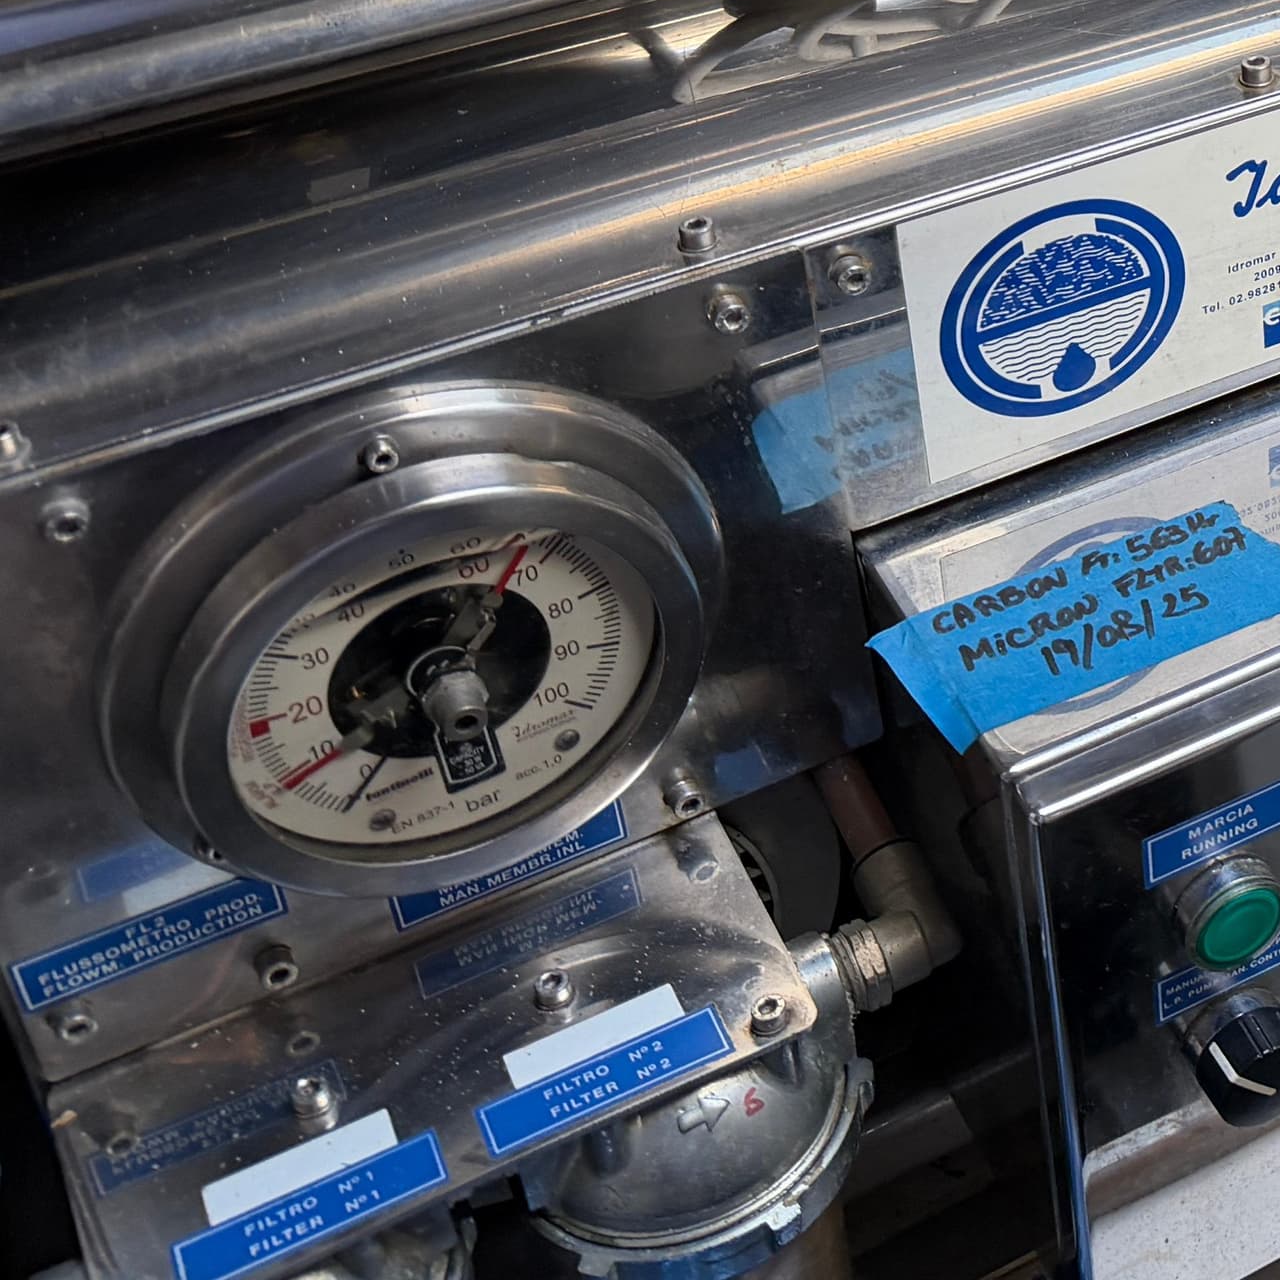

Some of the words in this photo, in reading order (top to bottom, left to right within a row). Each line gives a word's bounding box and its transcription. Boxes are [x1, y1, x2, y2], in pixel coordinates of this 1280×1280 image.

[1227, 251, 1276, 274] Idromar
[1202, 302, 1225, 315] Tel.
[513, 564, 539, 586] 70
[932, 567, 1068, 634] CARBON
[1126, 524, 1189, 562] 563
[548, 597, 574, 620] 80
[301, 647, 330, 670] 30
[554, 639, 580, 661] 90
[534, 682, 570, 708] 100
[288, 696, 323, 724] 20
[465, 790, 501, 813] bar
[1188, 803, 1254, 840] MARCIA
[1181, 818, 1259, 861] RUNNING
[439, 885, 485, 908] MAN.
[38, 919, 192, 986] FLUSSOMETRO
[204, 893, 262, 921] PROD.
[43, 959, 123, 998] FLOWM.
[133, 904, 263, 962] PRODUCTION
[542, 1064, 610, 1101] FILTRO
[550, 1081, 620, 1118] FILTER
[244, 1195, 318, 1237] FILTRO
[249, 1215, 325, 1258] FILTER
